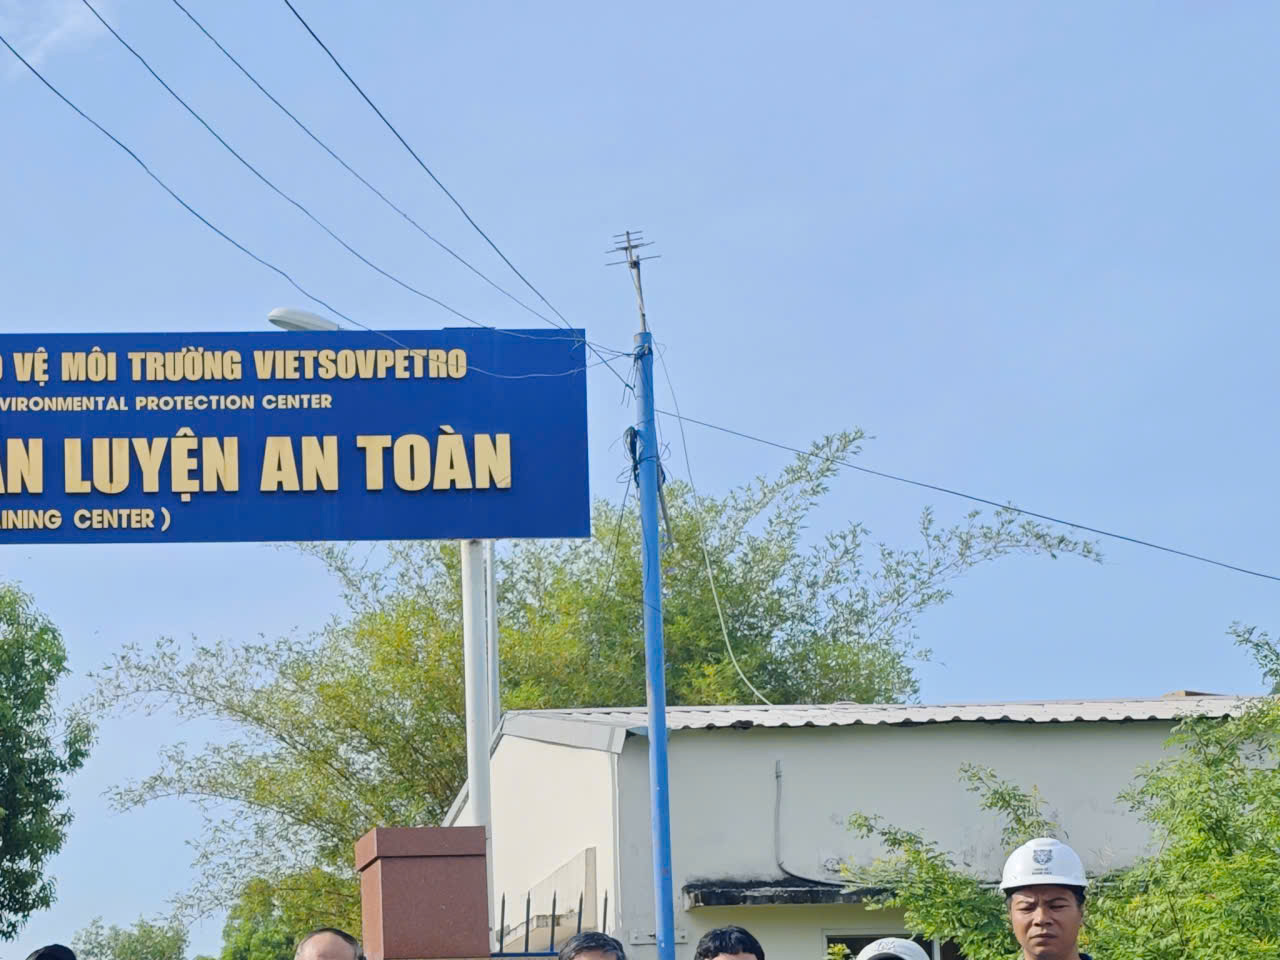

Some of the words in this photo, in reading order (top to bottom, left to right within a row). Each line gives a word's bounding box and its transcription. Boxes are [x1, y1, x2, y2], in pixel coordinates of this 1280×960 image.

[14, 347, 49, 387] VỆ
[62, 346, 117, 381] MÔI
[128, 345, 242, 381] TRƯỜNG
[254, 347, 467, 380] VIETSOVPETRO
[135, 394, 255, 411] PROTECTION
[262, 393, 332, 409] CENTER
[64, 426, 239, 502] LUYỆN
[261, 435, 339, 492] AN
[357, 425, 512, 491] TOÀN
